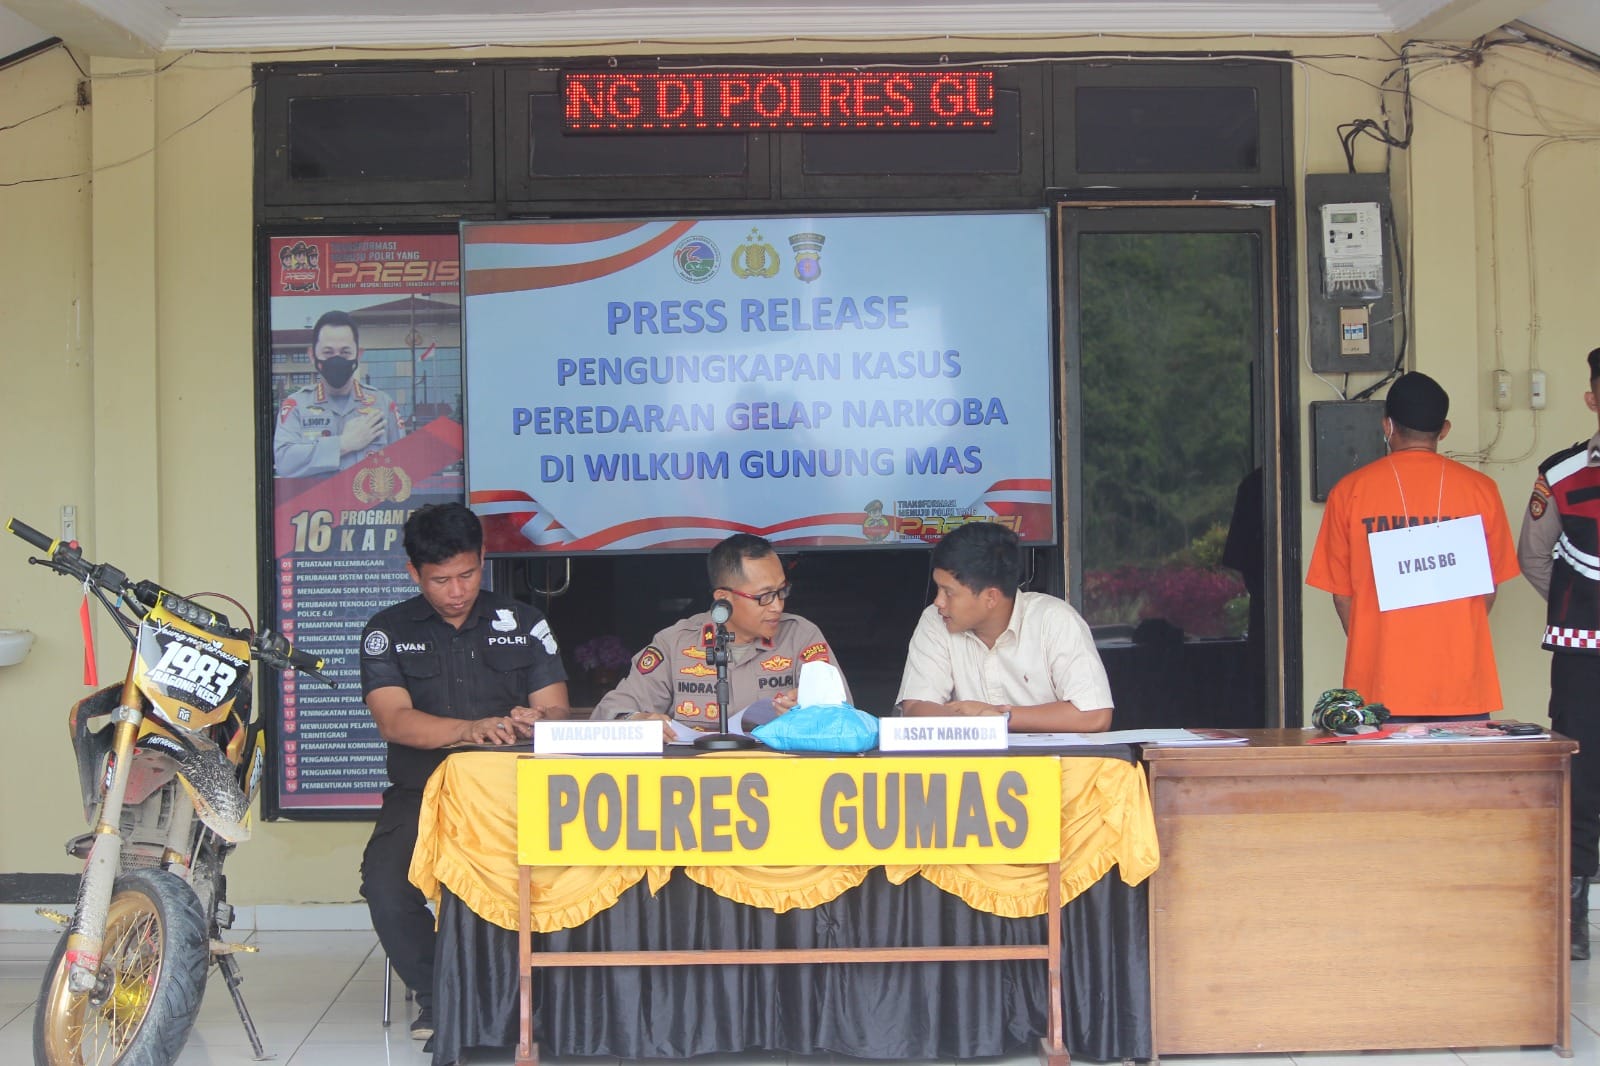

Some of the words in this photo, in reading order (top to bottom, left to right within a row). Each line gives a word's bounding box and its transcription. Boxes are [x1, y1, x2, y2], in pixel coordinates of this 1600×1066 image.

[656, 79, 702, 118] DI
[719, 76, 914, 118] POLRES
[332, 261, 459, 282] PRESIS
[607, 300, 727, 335] PRESS
[740, 296, 909, 331] RELEASE
[557, 353, 840, 386] PENGUNGKAPAN
[852, 350, 962, 380] KASUS
[512, 403, 715, 435] PEREDARAN
[726, 400, 832, 431] GELAP
[843, 397, 1008, 428] NARKOBA
[540, 454, 574, 483] DI
[584, 450, 729, 482] WILKUM
[740, 447, 894, 480] GUNUNG
[905, 445, 982, 475] MAS
[340, 510, 406, 526] PROGRAM
[291, 510, 334, 553] 16
[1398, 560, 1411, 574] LY
[1414, 556, 1436, 572] ALS
[1438, 552, 1456, 568] BG
[395, 642, 426, 653] EVAN
[488, 635, 527, 646] POLRI
[147, 640, 237, 702] 1983
[300, 709, 347, 717] PENINGKATAN
[551, 726, 644, 741] WAKAPOLRES
[894, 727, 935, 740] KASAT
[937, 726, 997, 740] NARKOBA
[302, 782, 352, 790] PEMBENTUKAN
[547, 772, 771, 853] POLRES
[820, 770, 1029, 850] GUMAS
